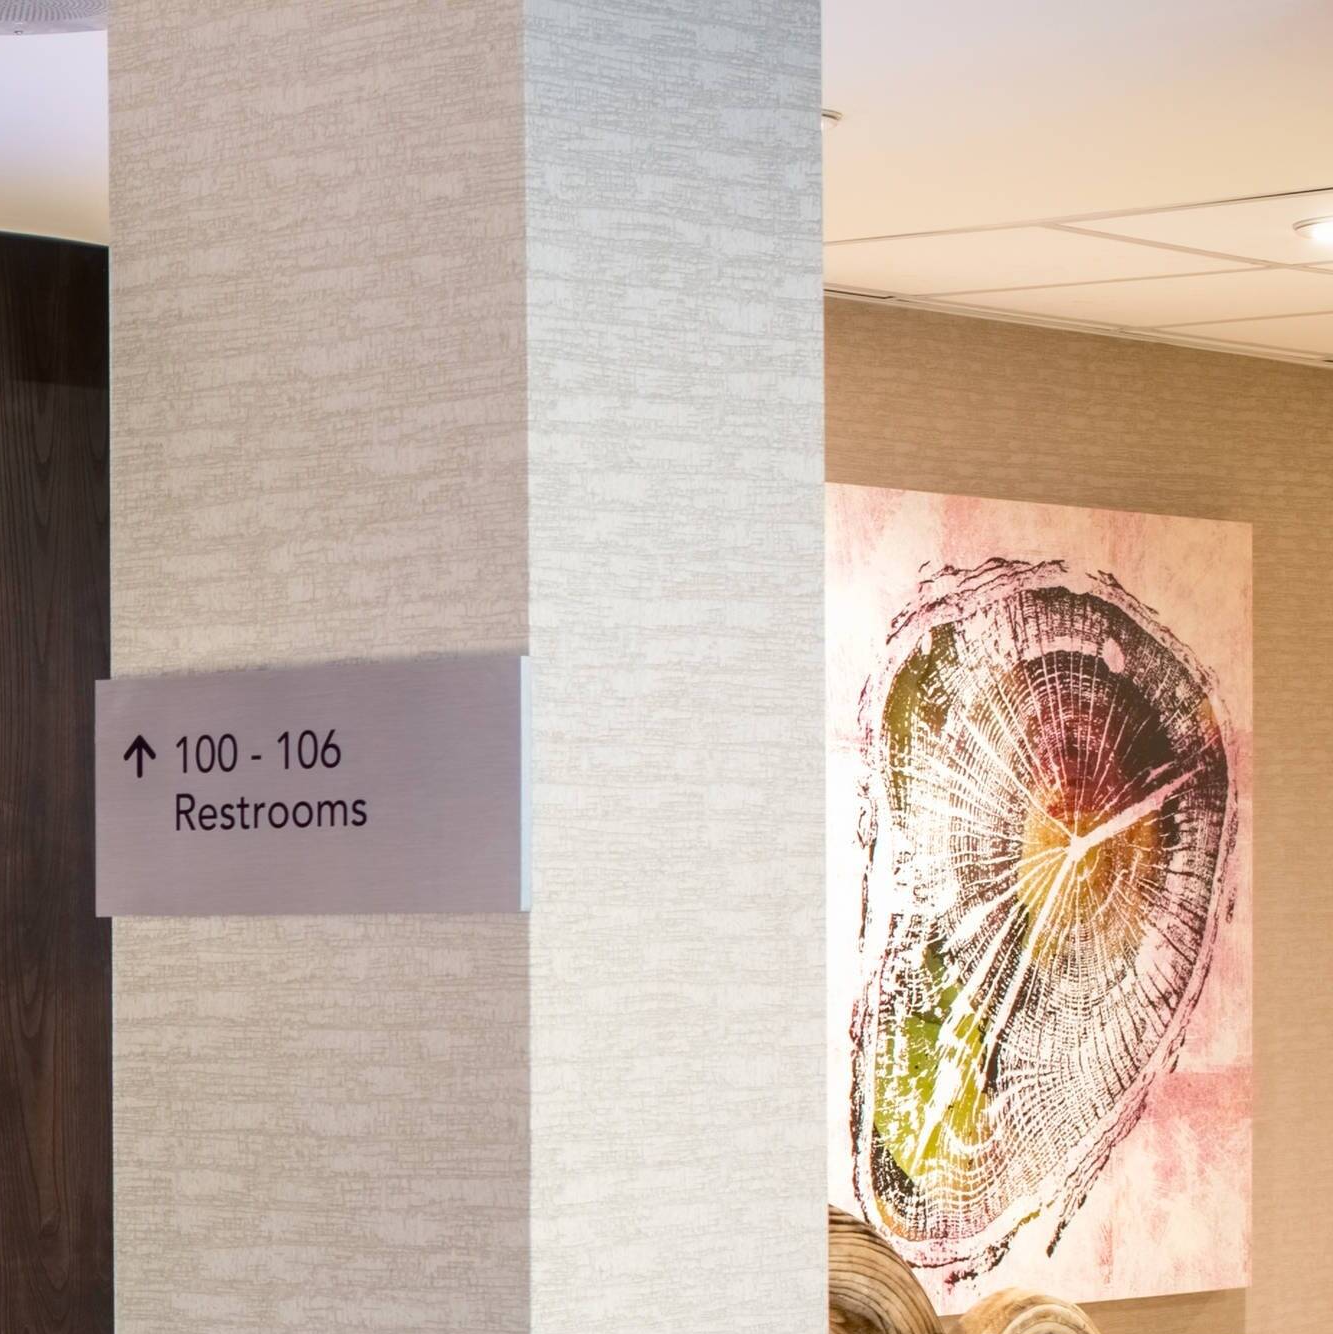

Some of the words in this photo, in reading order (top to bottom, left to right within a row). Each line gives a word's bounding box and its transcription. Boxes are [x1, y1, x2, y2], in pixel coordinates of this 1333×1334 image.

[175, 733, 238, 774] 100
[277, 729, 341, 770] 106
[175, 793, 368, 831] Restrooms
